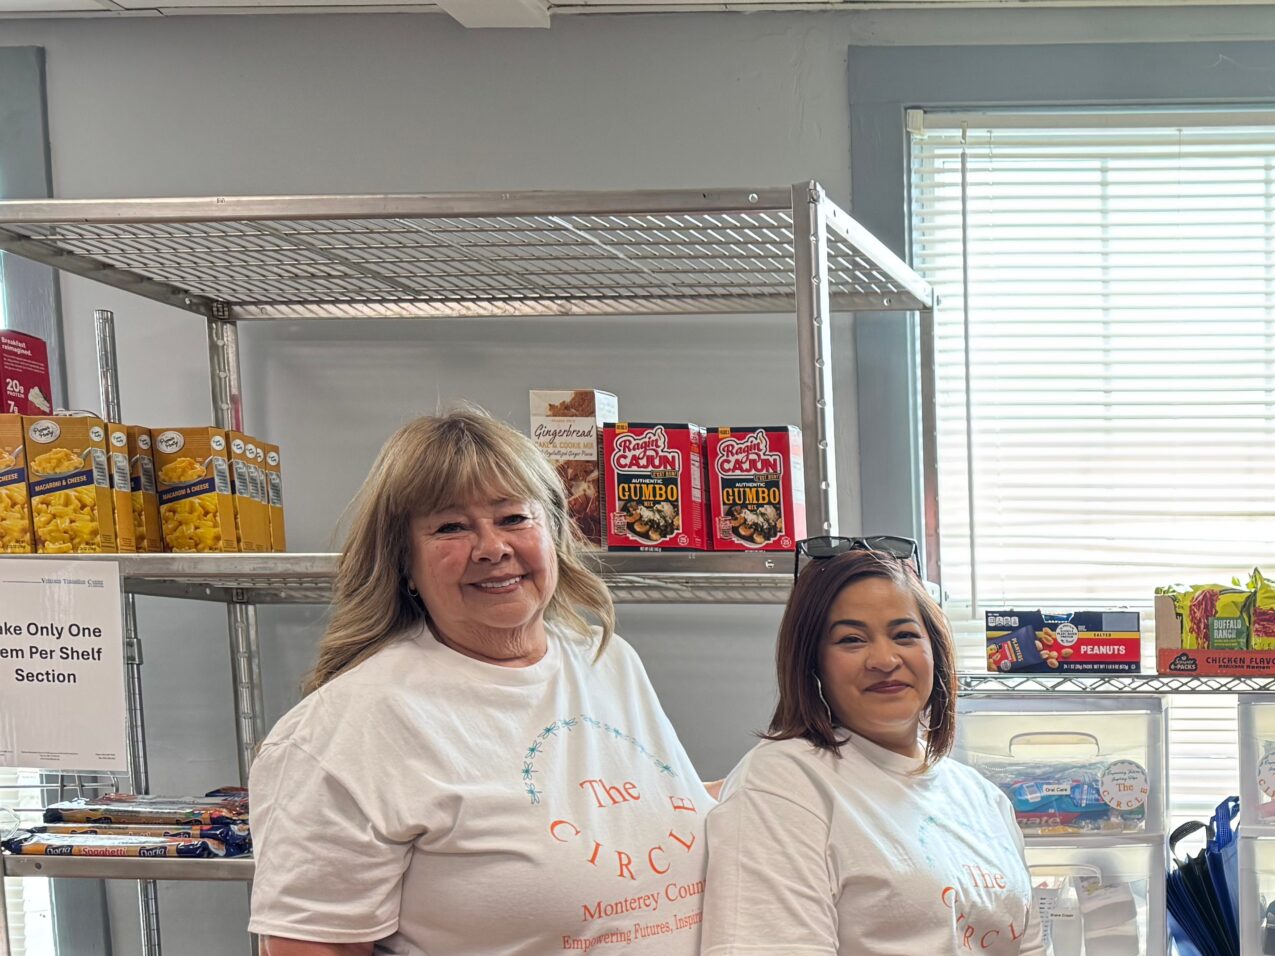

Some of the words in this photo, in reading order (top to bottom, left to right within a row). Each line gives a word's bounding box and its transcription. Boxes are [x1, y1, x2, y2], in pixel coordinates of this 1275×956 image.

[6, 378, 24, 394] 20g
[7, 400, 18, 414] 7g
[535, 424, 593, 445] Gingerbread
[616, 455, 677, 470] CAJUN
[720, 458, 778, 473] CAJUN
[35, 481, 61, 492] MACARONI
[68, 475, 87, 484] CHEESE
[163, 488, 187, 500] MACARONI
[192, 483, 209, 493] CHEESE
[619, 484, 678, 501] GUMBO
[723, 488, 779, 504] GUMBO
[27, 622, 64, 640] Only
[68, 623, 102, 638] One
[1213, 619, 1241, 629] BUFFALO
[1213, 629, 1237, 639] RANCH
[29, 646, 55, 660] Per
[59, 647, 102, 661] Shelf
[1081, 645, 1126, 655] PEANUTS
[1206, 656, 1246, 665] CHICKEN
[15, 668, 77, 684] Section
[579, 778, 641, 808] The
[1116, 783, 1134, 792] The
[1102, 788, 1148, 808] CIRCLE
[550, 795, 697, 881] CIRCLE
[963, 864, 1006, 889] The
[581, 891, 660, 922] Monterey
[665, 879, 706, 901] Coun
[562, 926, 631, 953] Empowering
[634, 918, 673, 940] Futures,
